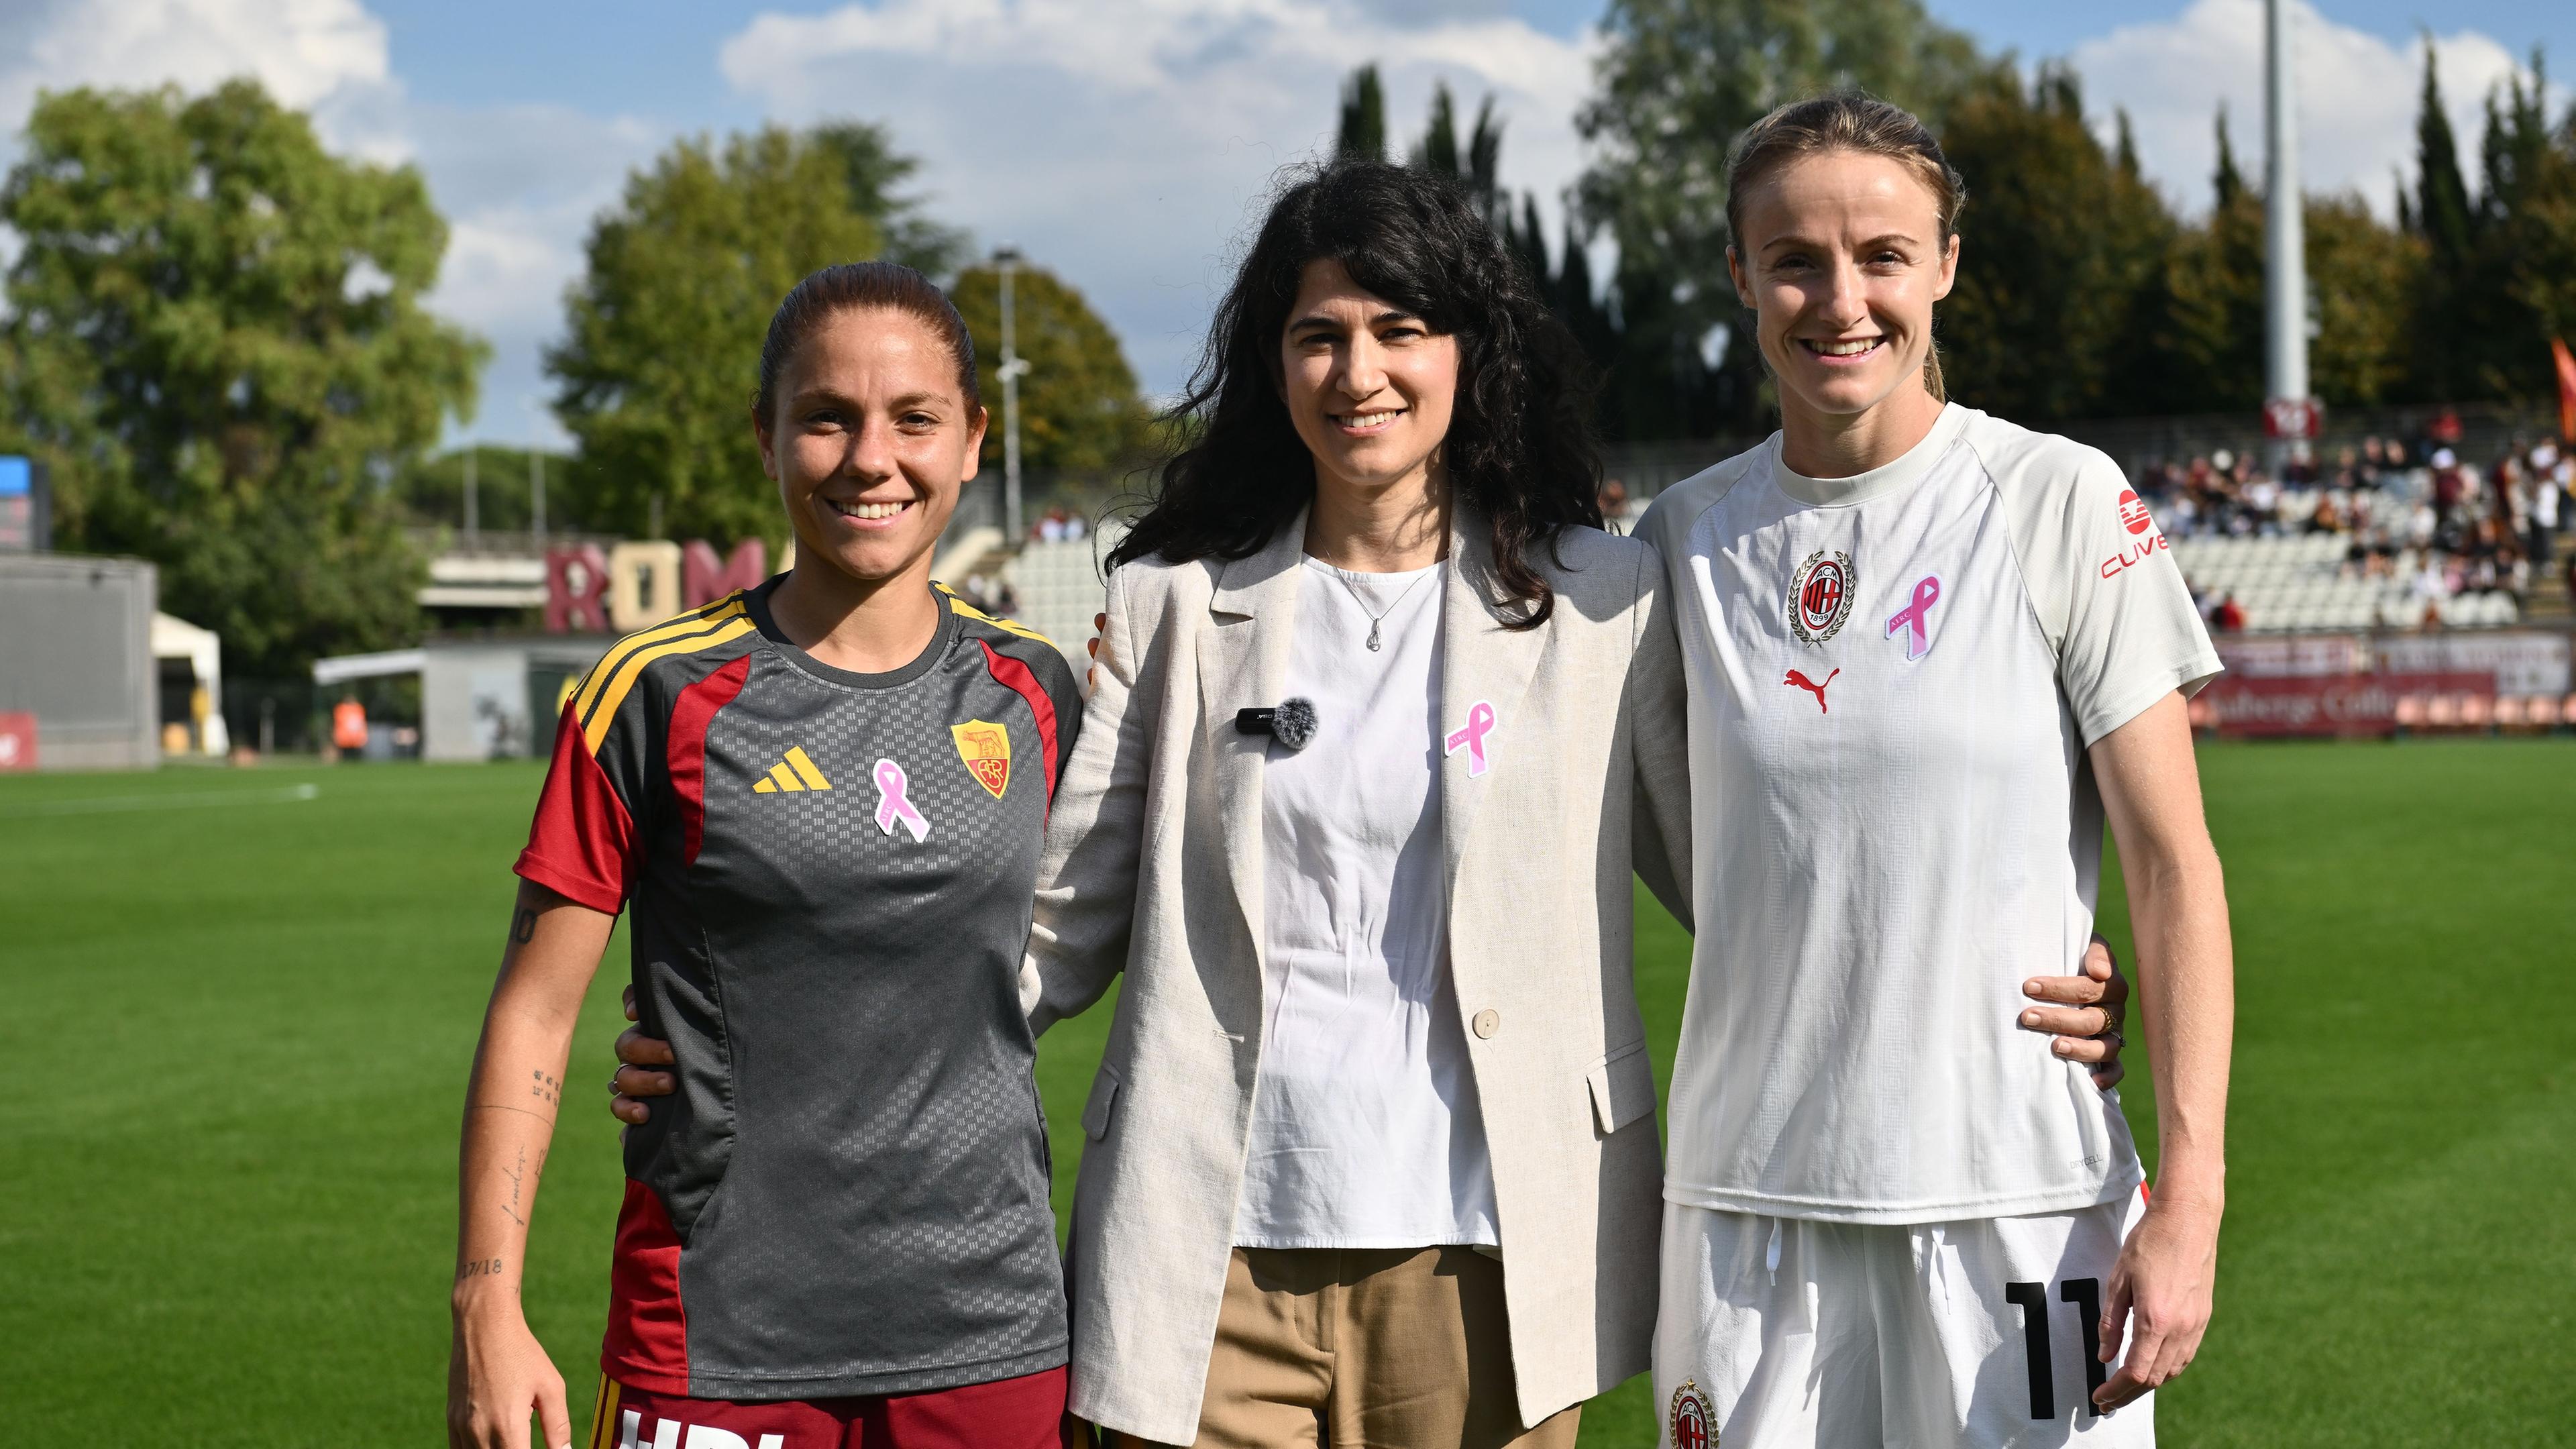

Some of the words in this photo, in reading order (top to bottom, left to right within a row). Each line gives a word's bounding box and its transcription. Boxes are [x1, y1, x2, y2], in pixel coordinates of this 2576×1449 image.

[1815, 567, 1837, 580] ACM
[545, 539, 796, 633] ROM
[1809, 613, 1829, 622] 1899
[1891, 611, 1911, 628] AIRC
[1449, 733, 1467, 745] AIRC
[2070, 1153, 2104, 1169] DRYCELL
[462, 1258, 502, 1279] 17/18
[2005, 1277, 2108, 1419] 11
[1681, 1403, 1701, 1419] ACM
